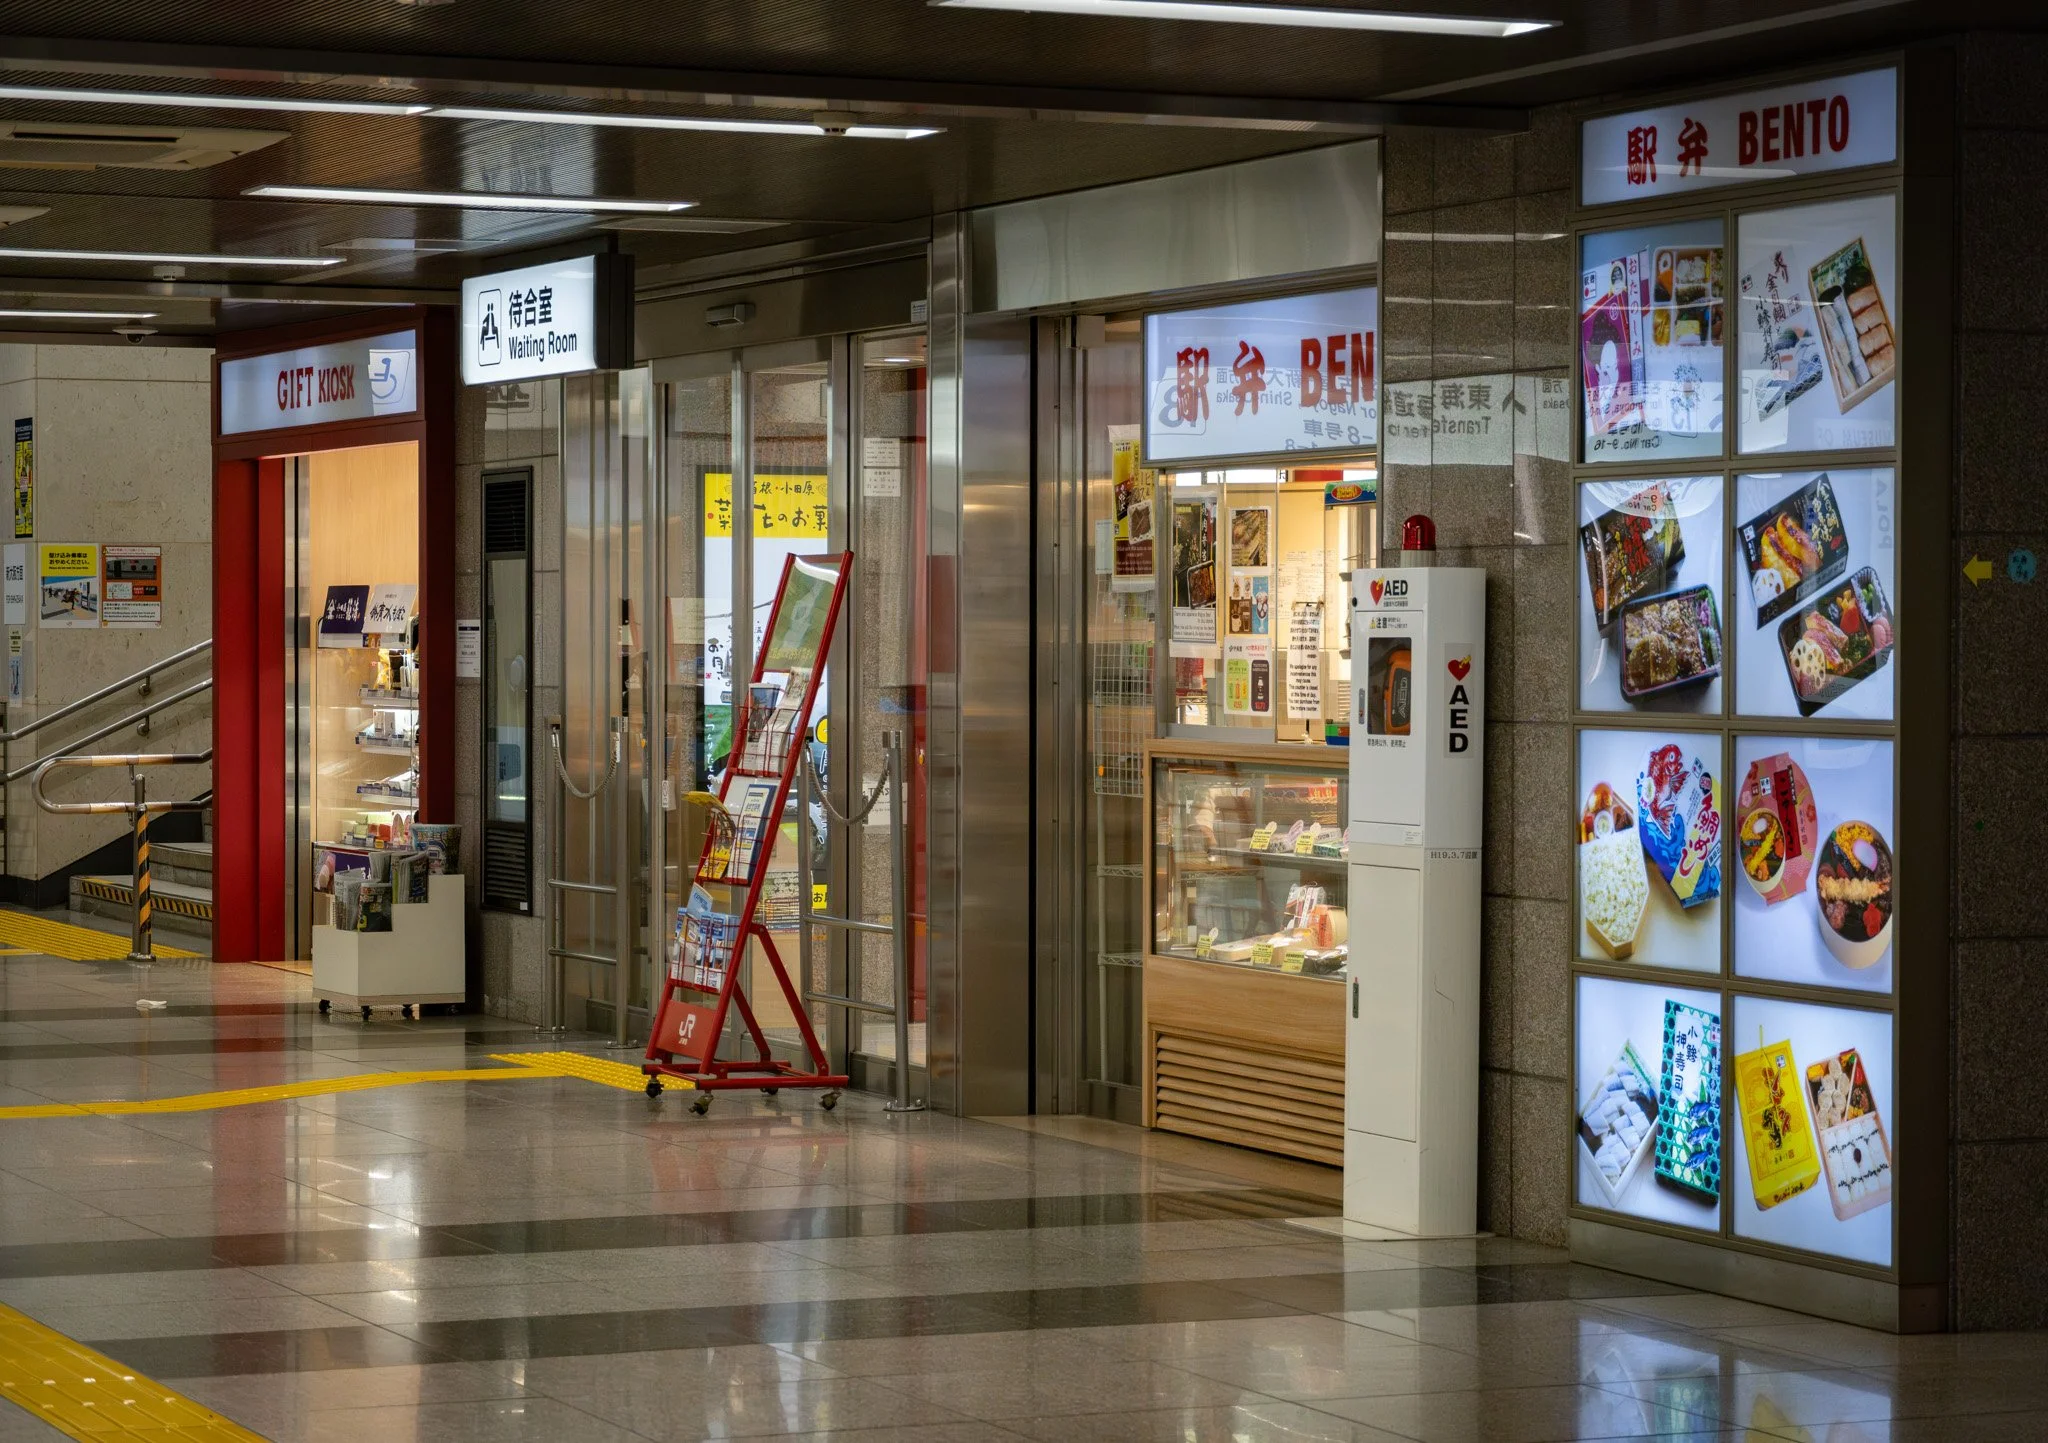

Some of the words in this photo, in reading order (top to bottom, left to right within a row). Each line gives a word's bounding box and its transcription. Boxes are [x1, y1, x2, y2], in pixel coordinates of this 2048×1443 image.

[1738, 94, 1850, 166] BENTO
[508, 285, 553, 329] 待合室
[1628, 256, 1642, 357] おたのしみ
[508, 334, 545, 362] Waiting
[548, 331, 578, 355] Room
[1300, 331, 1375, 408] BEN
[277, 366, 314, 411] GIFT
[318, 364, 355, 403] KIOSK
[1384, 579, 1408, 596] AED
[1449, 684, 1470, 753] AED
